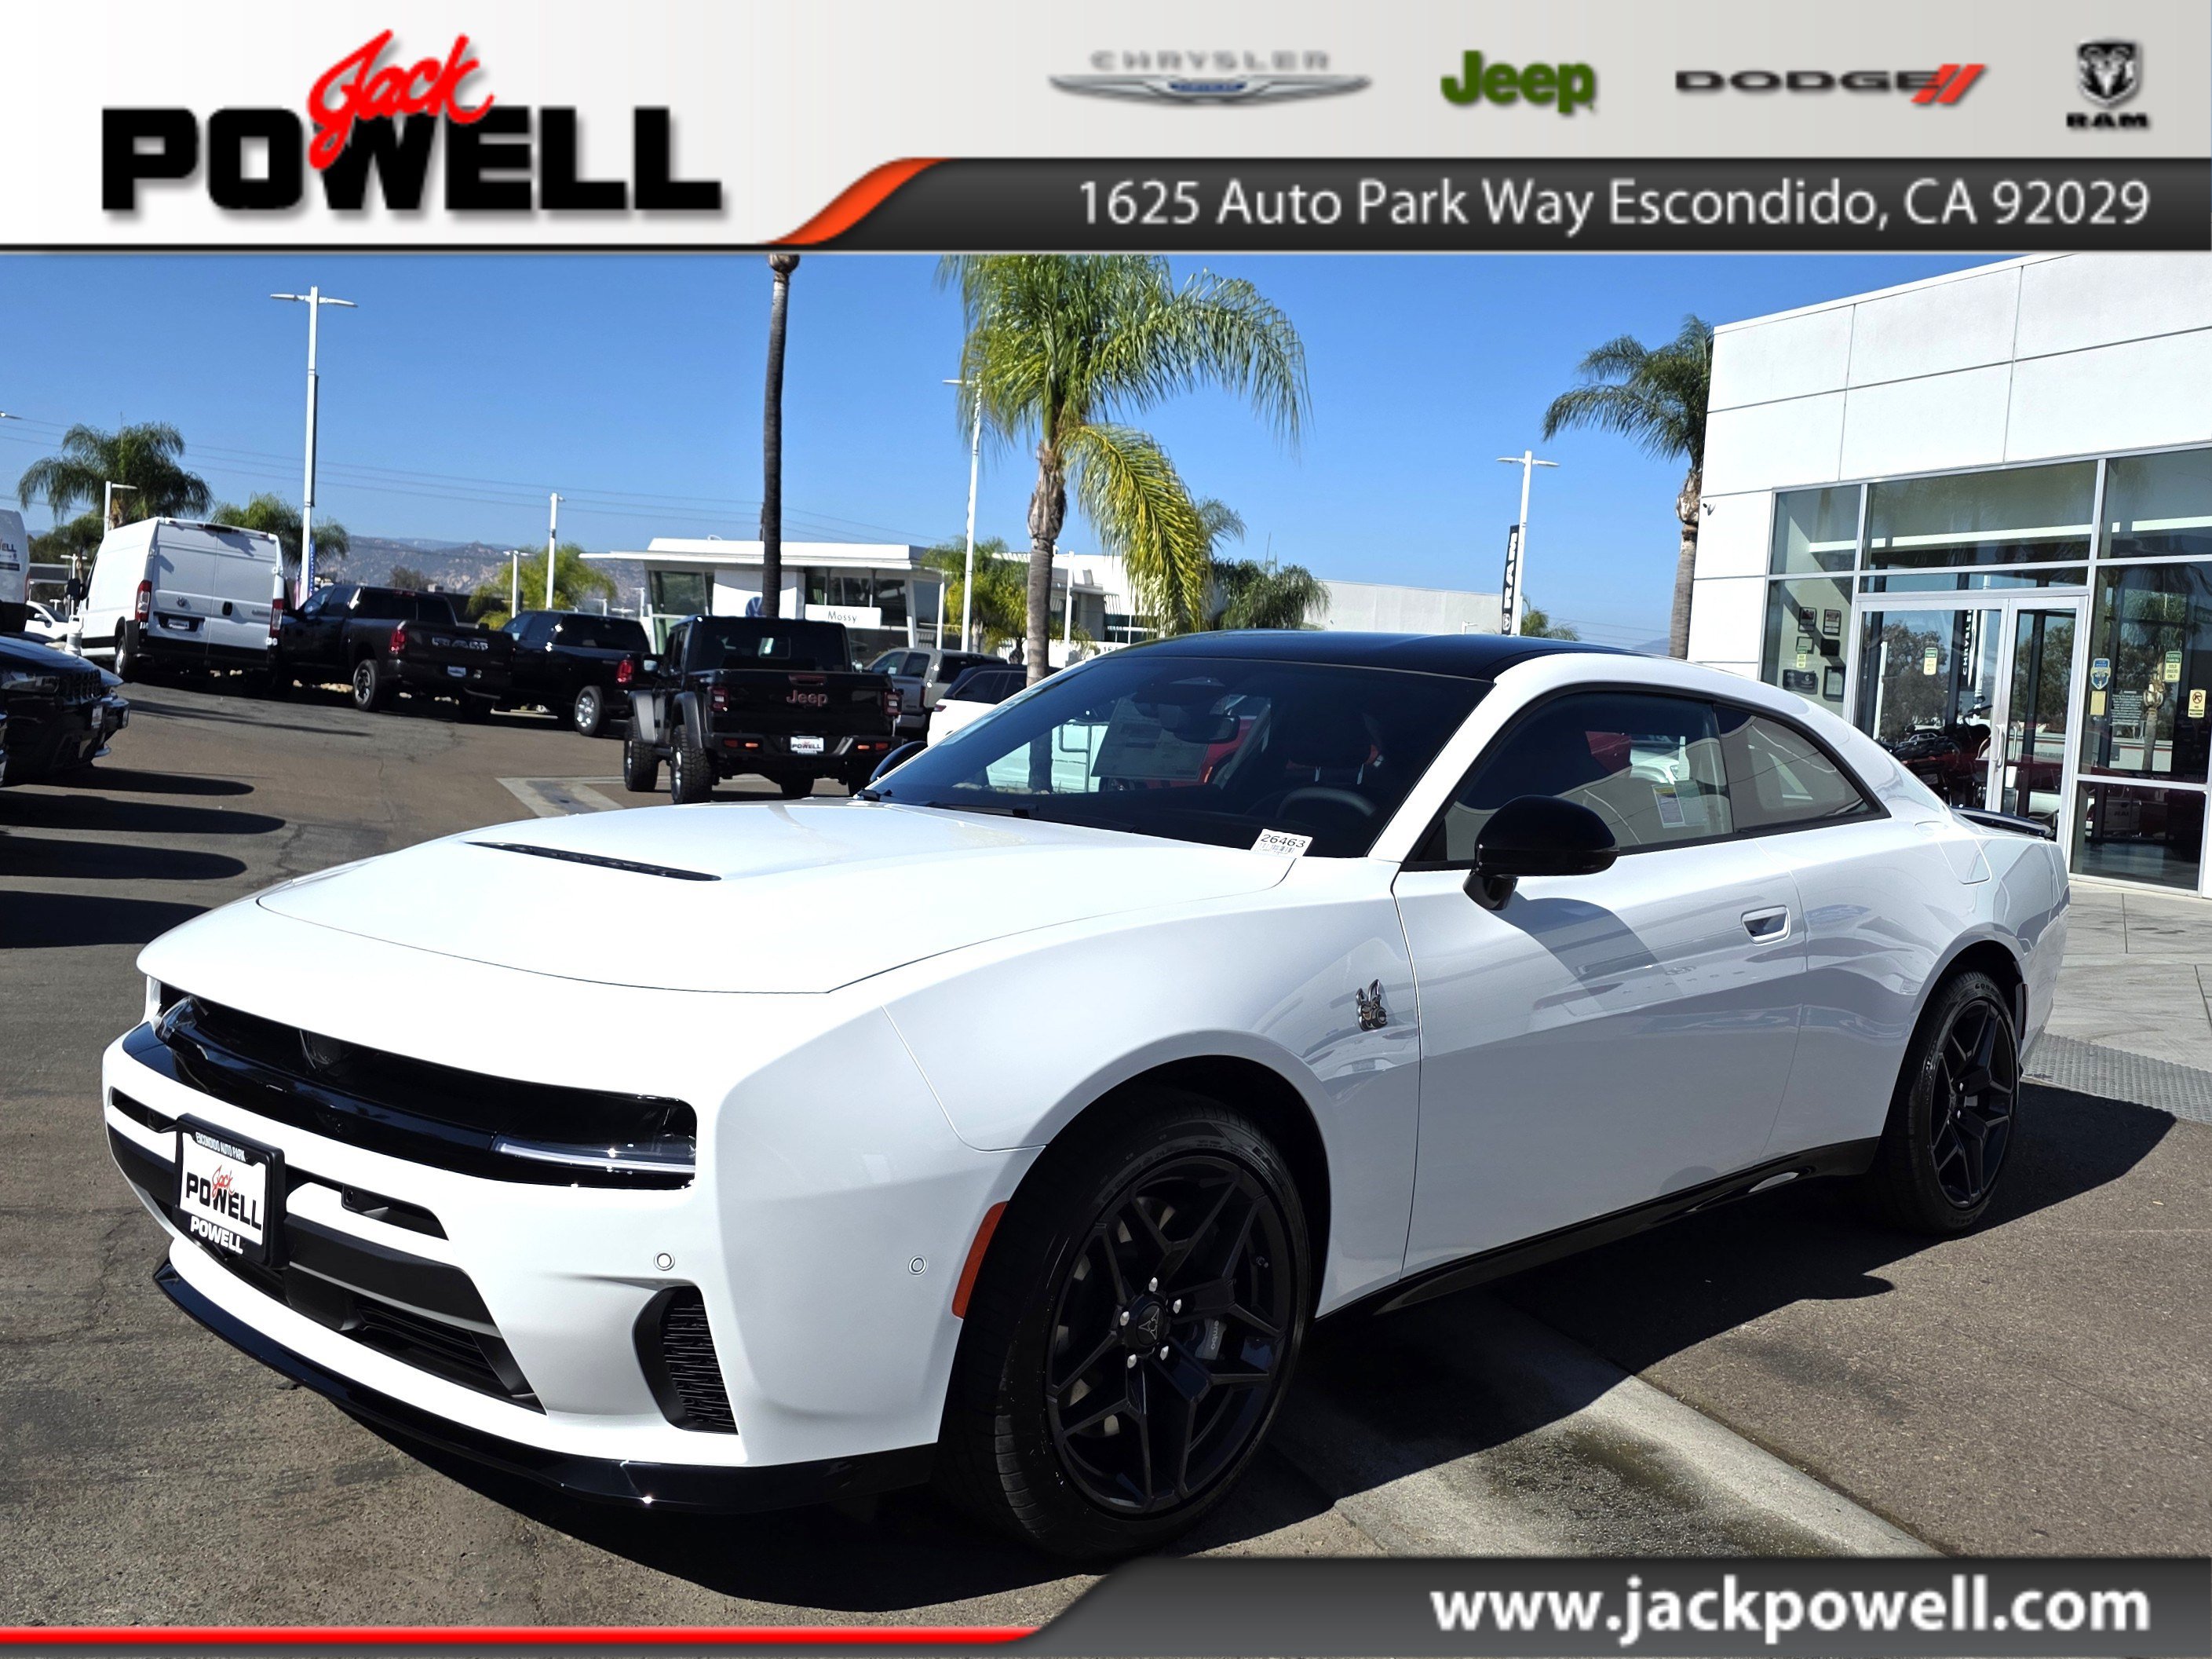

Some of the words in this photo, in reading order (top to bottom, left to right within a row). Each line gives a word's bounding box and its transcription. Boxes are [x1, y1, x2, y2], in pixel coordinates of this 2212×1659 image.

[1503, 532, 1518, 608] RAM
[827, 610, 858, 624] Mossy
[786, 689, 829, 707] Jeep
[1261, 834, 1306, 848] 26463
[212, 1164, 235, 1198] Jack
[186, 1171, 261, 1231] POWELL
[190, 1215, 243, 1255] POWELL
